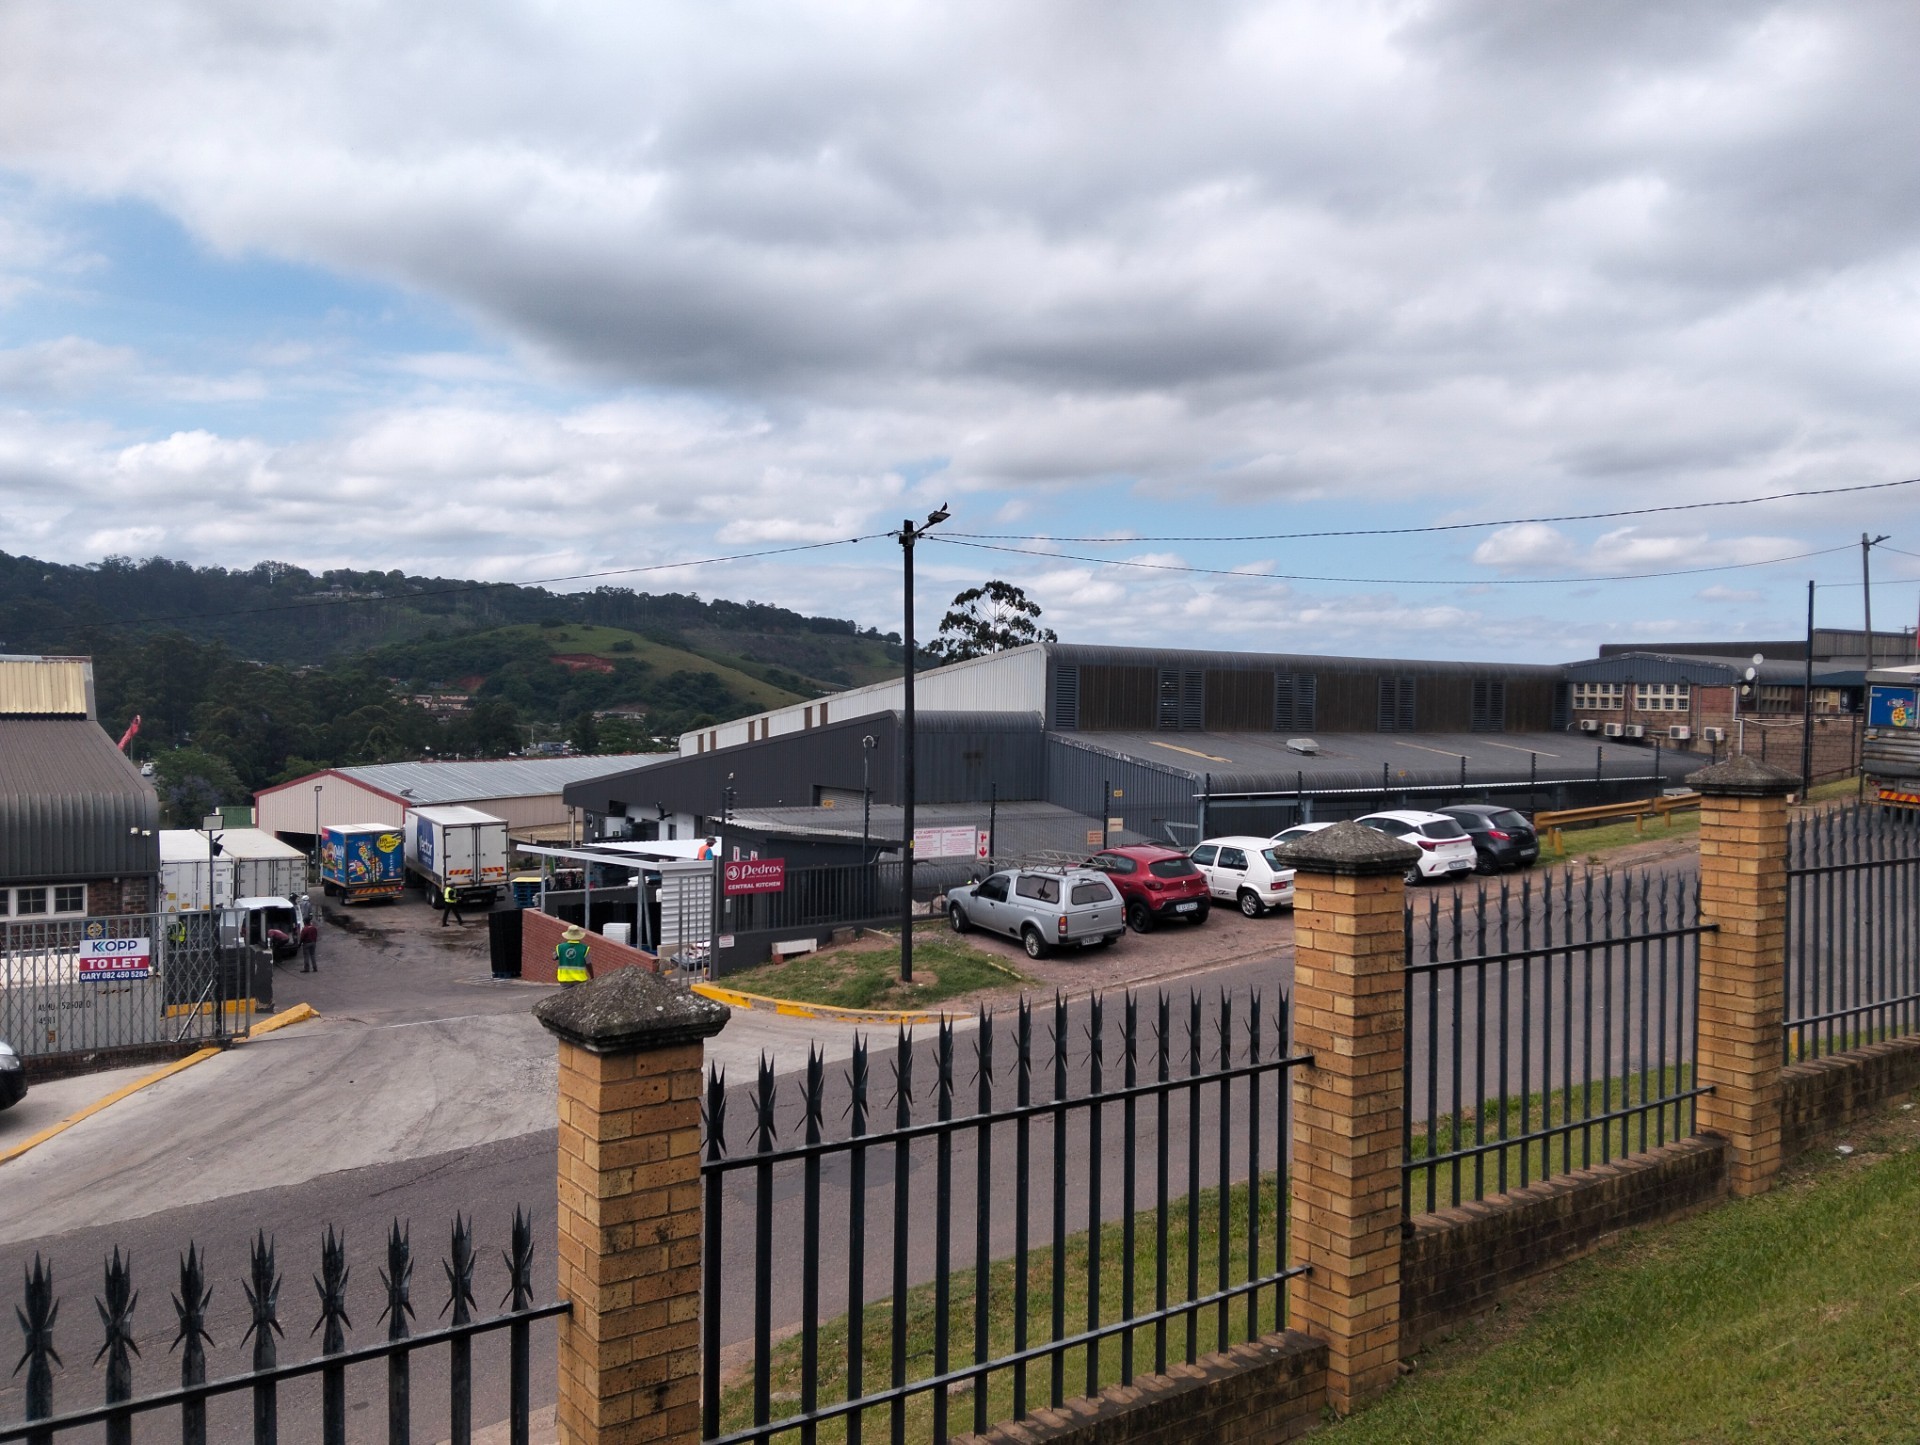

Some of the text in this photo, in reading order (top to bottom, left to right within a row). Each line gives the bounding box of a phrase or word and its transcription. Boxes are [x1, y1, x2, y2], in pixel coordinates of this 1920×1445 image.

[741, 864, 781, 879] Pedros
[92, 940, 137, 952] KOPP
[87, 957, 141, 969] TO LET
[81, 972, 101, 980] GARY
[102, 971, 115, 979] 082
[131, 970, 148, 978] 5284
